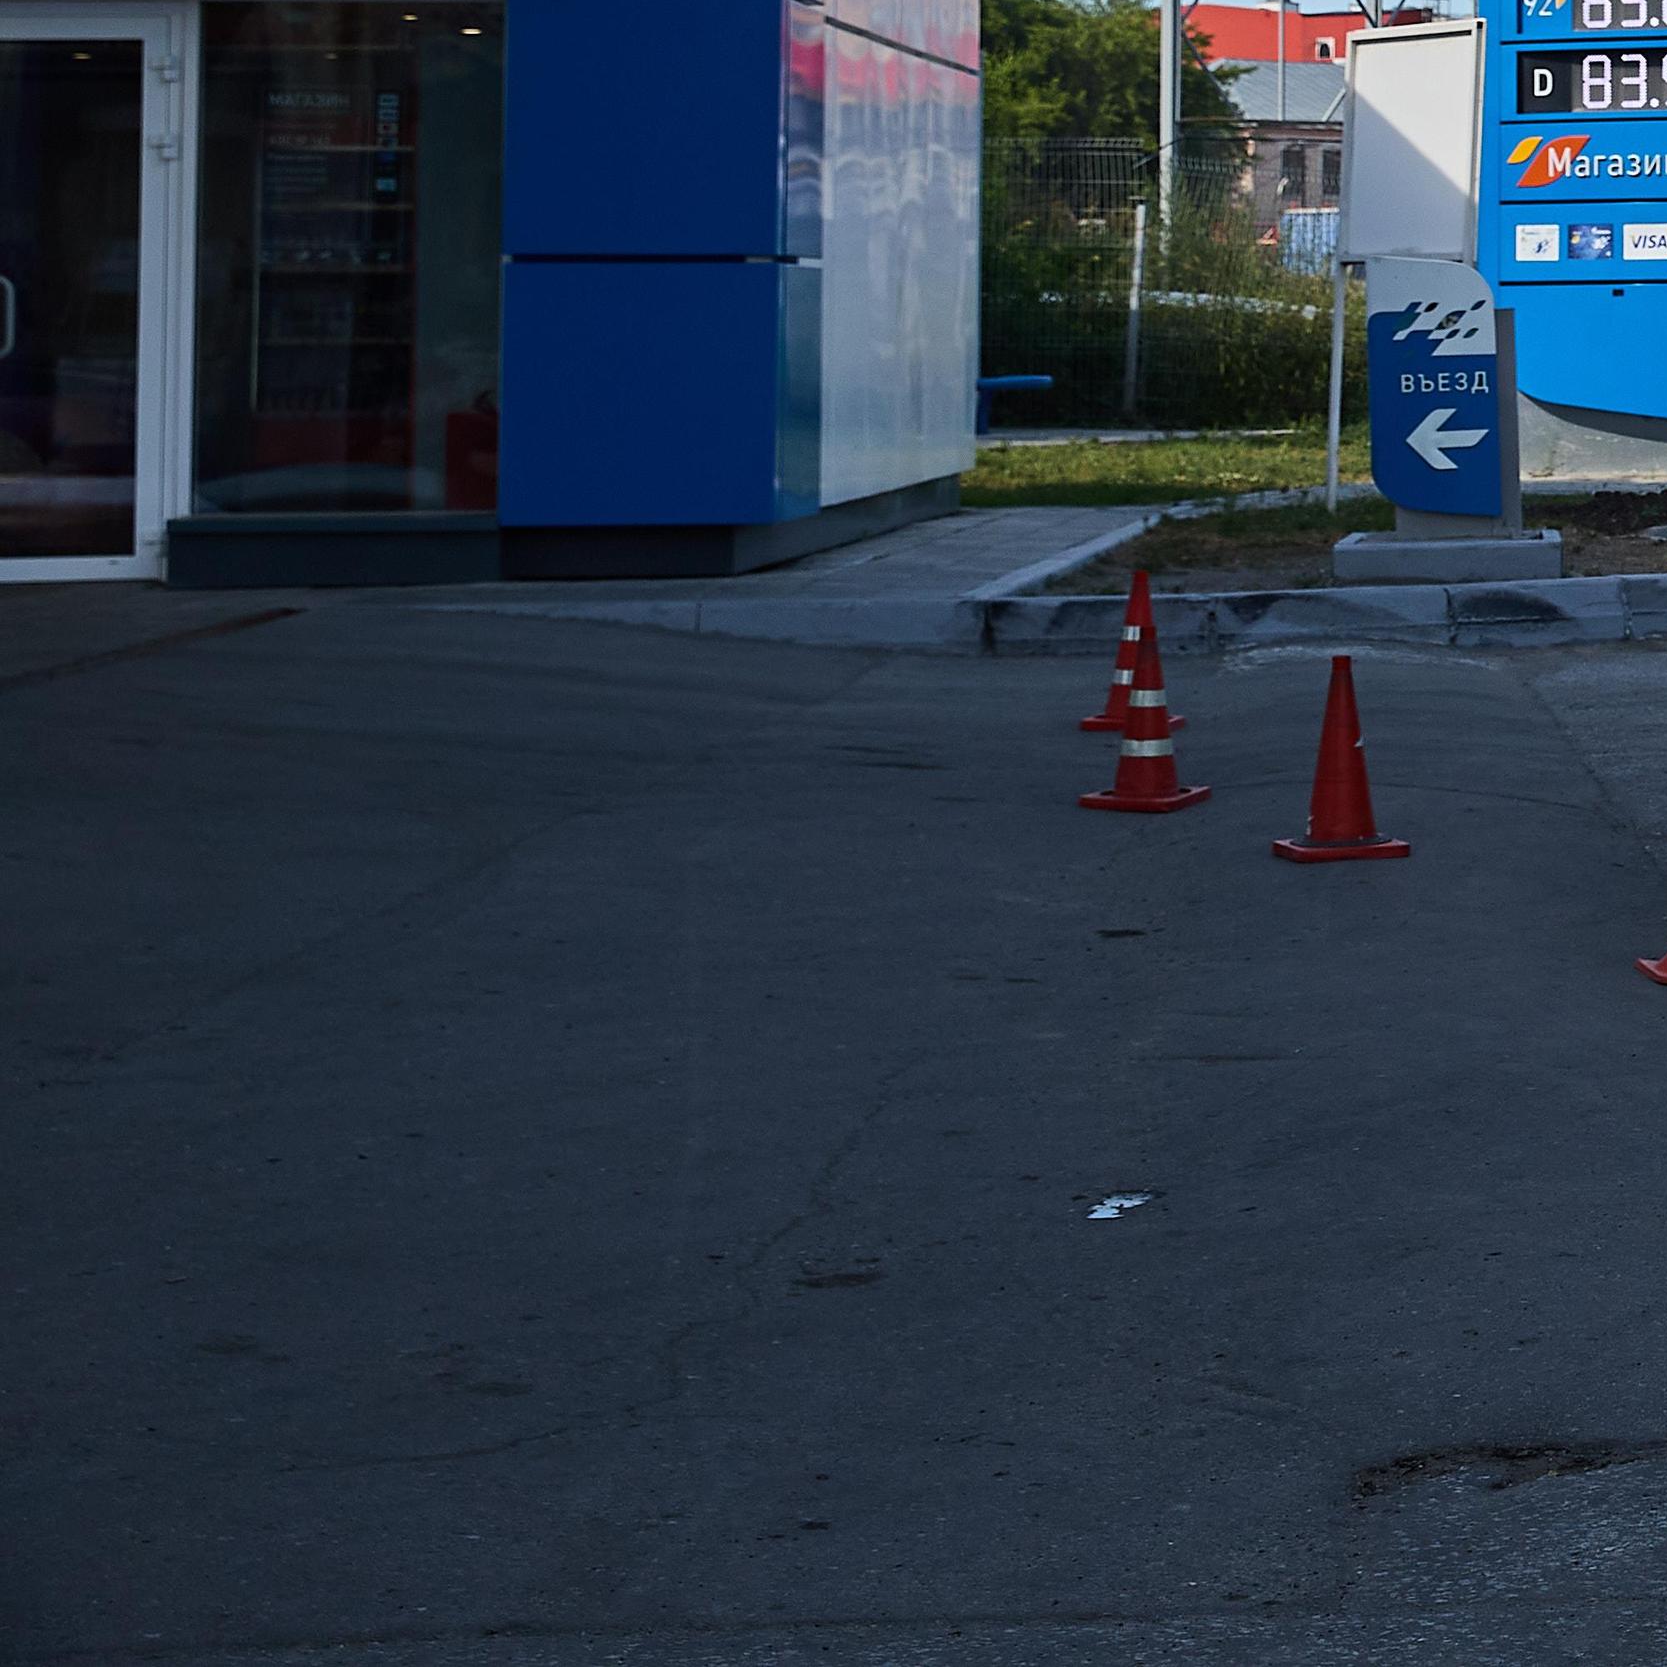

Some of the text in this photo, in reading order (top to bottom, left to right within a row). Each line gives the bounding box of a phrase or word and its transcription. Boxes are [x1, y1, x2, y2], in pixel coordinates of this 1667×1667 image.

[1533, 69, 1554, 97] D
[1631, 235, 1667, 249] VISA
[1401, 371, 1489, 394] ВЪЕЗД
